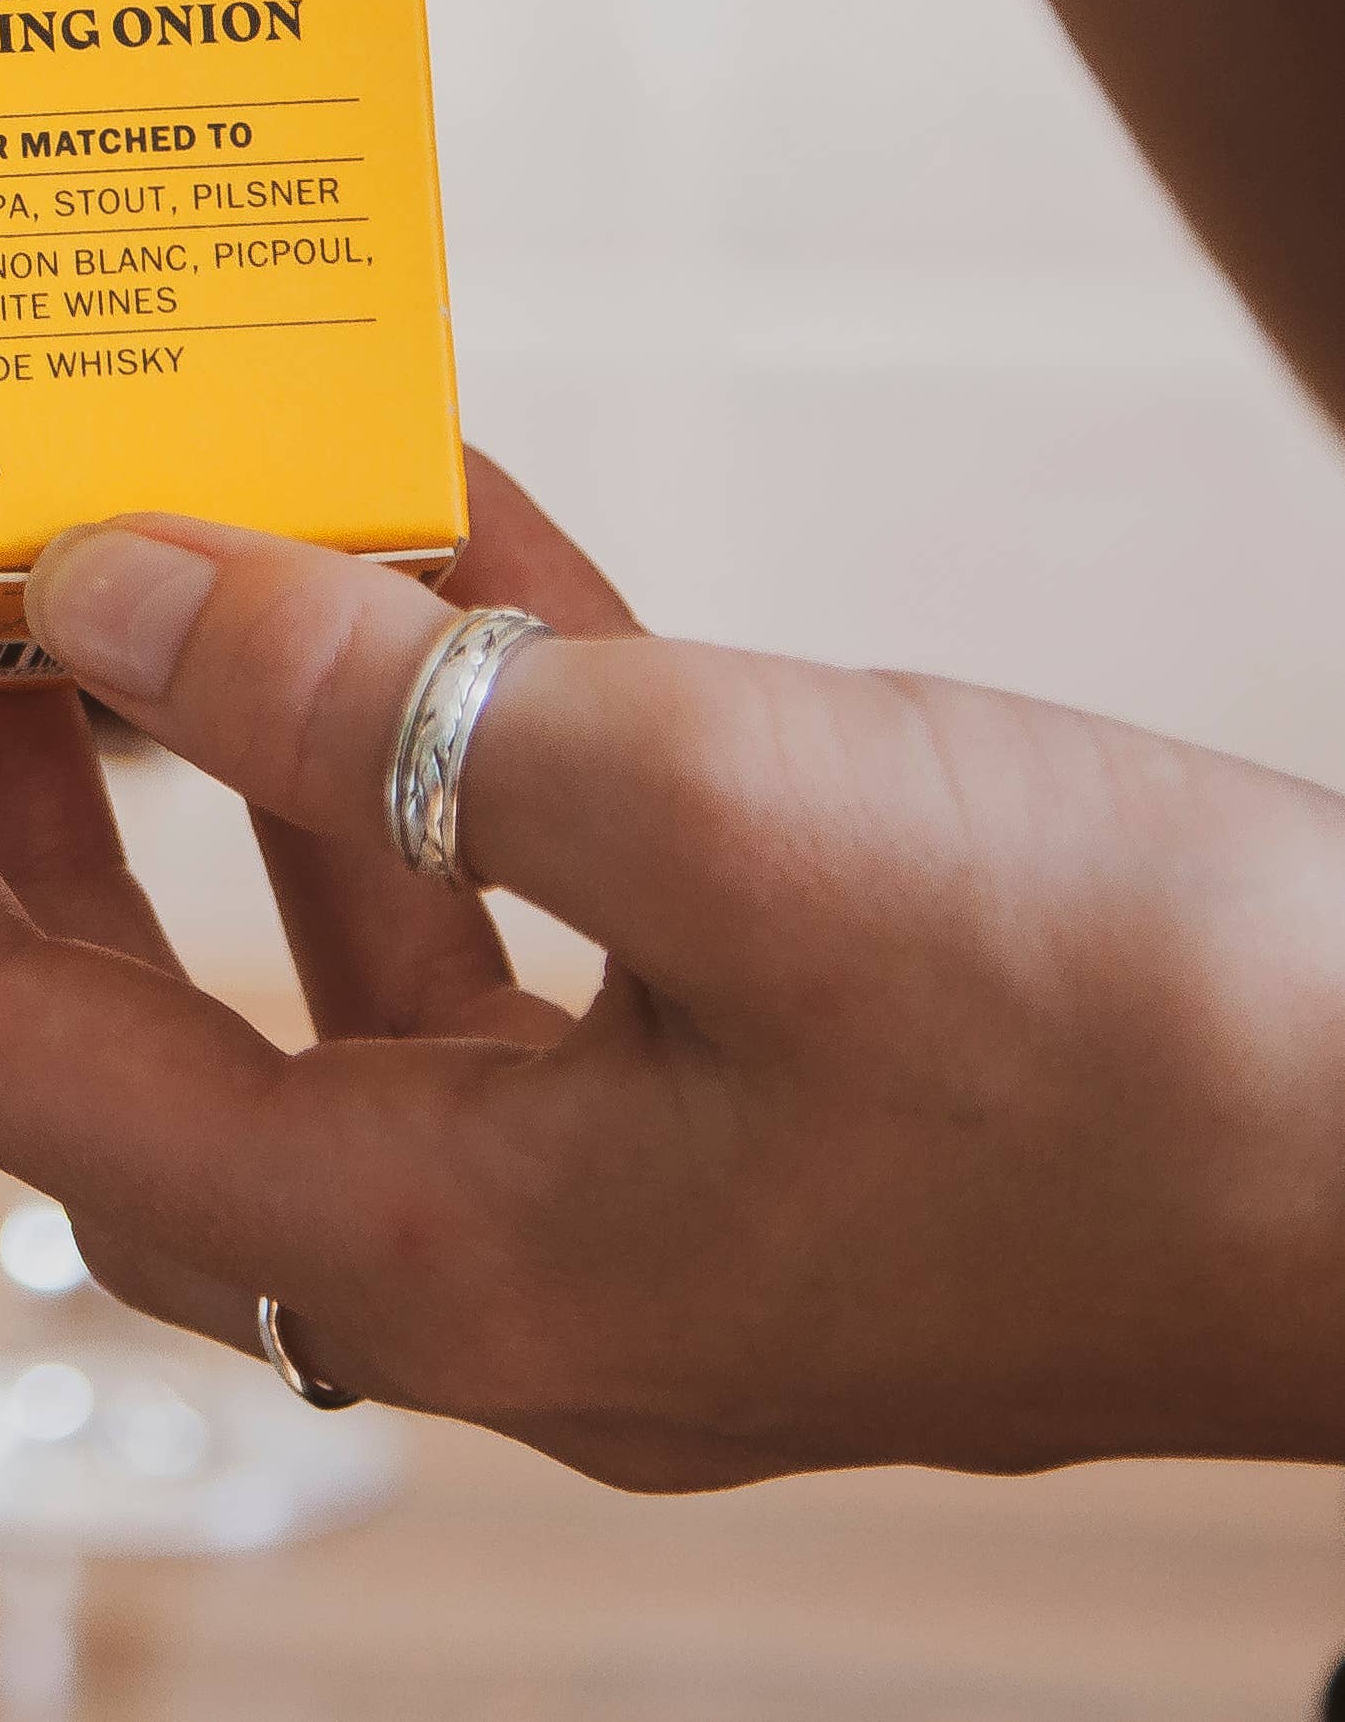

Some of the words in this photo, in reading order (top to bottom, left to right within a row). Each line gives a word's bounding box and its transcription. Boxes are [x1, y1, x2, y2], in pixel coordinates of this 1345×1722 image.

[113, 0, 303, 47] ONION
[21, 125, 196, 158] MATCHED
[208, 122, 252, 149] TO
[55, 186, 176, 216] STOUT,
[194, 178, 339, 210] PILSNER
[75, 245, 198, 275] BLANC,
[215, 237, 372, 269] PICPOUL,
[64, 287, 177, 317] WINES
[46, 346, 184, 378] WHISKY
